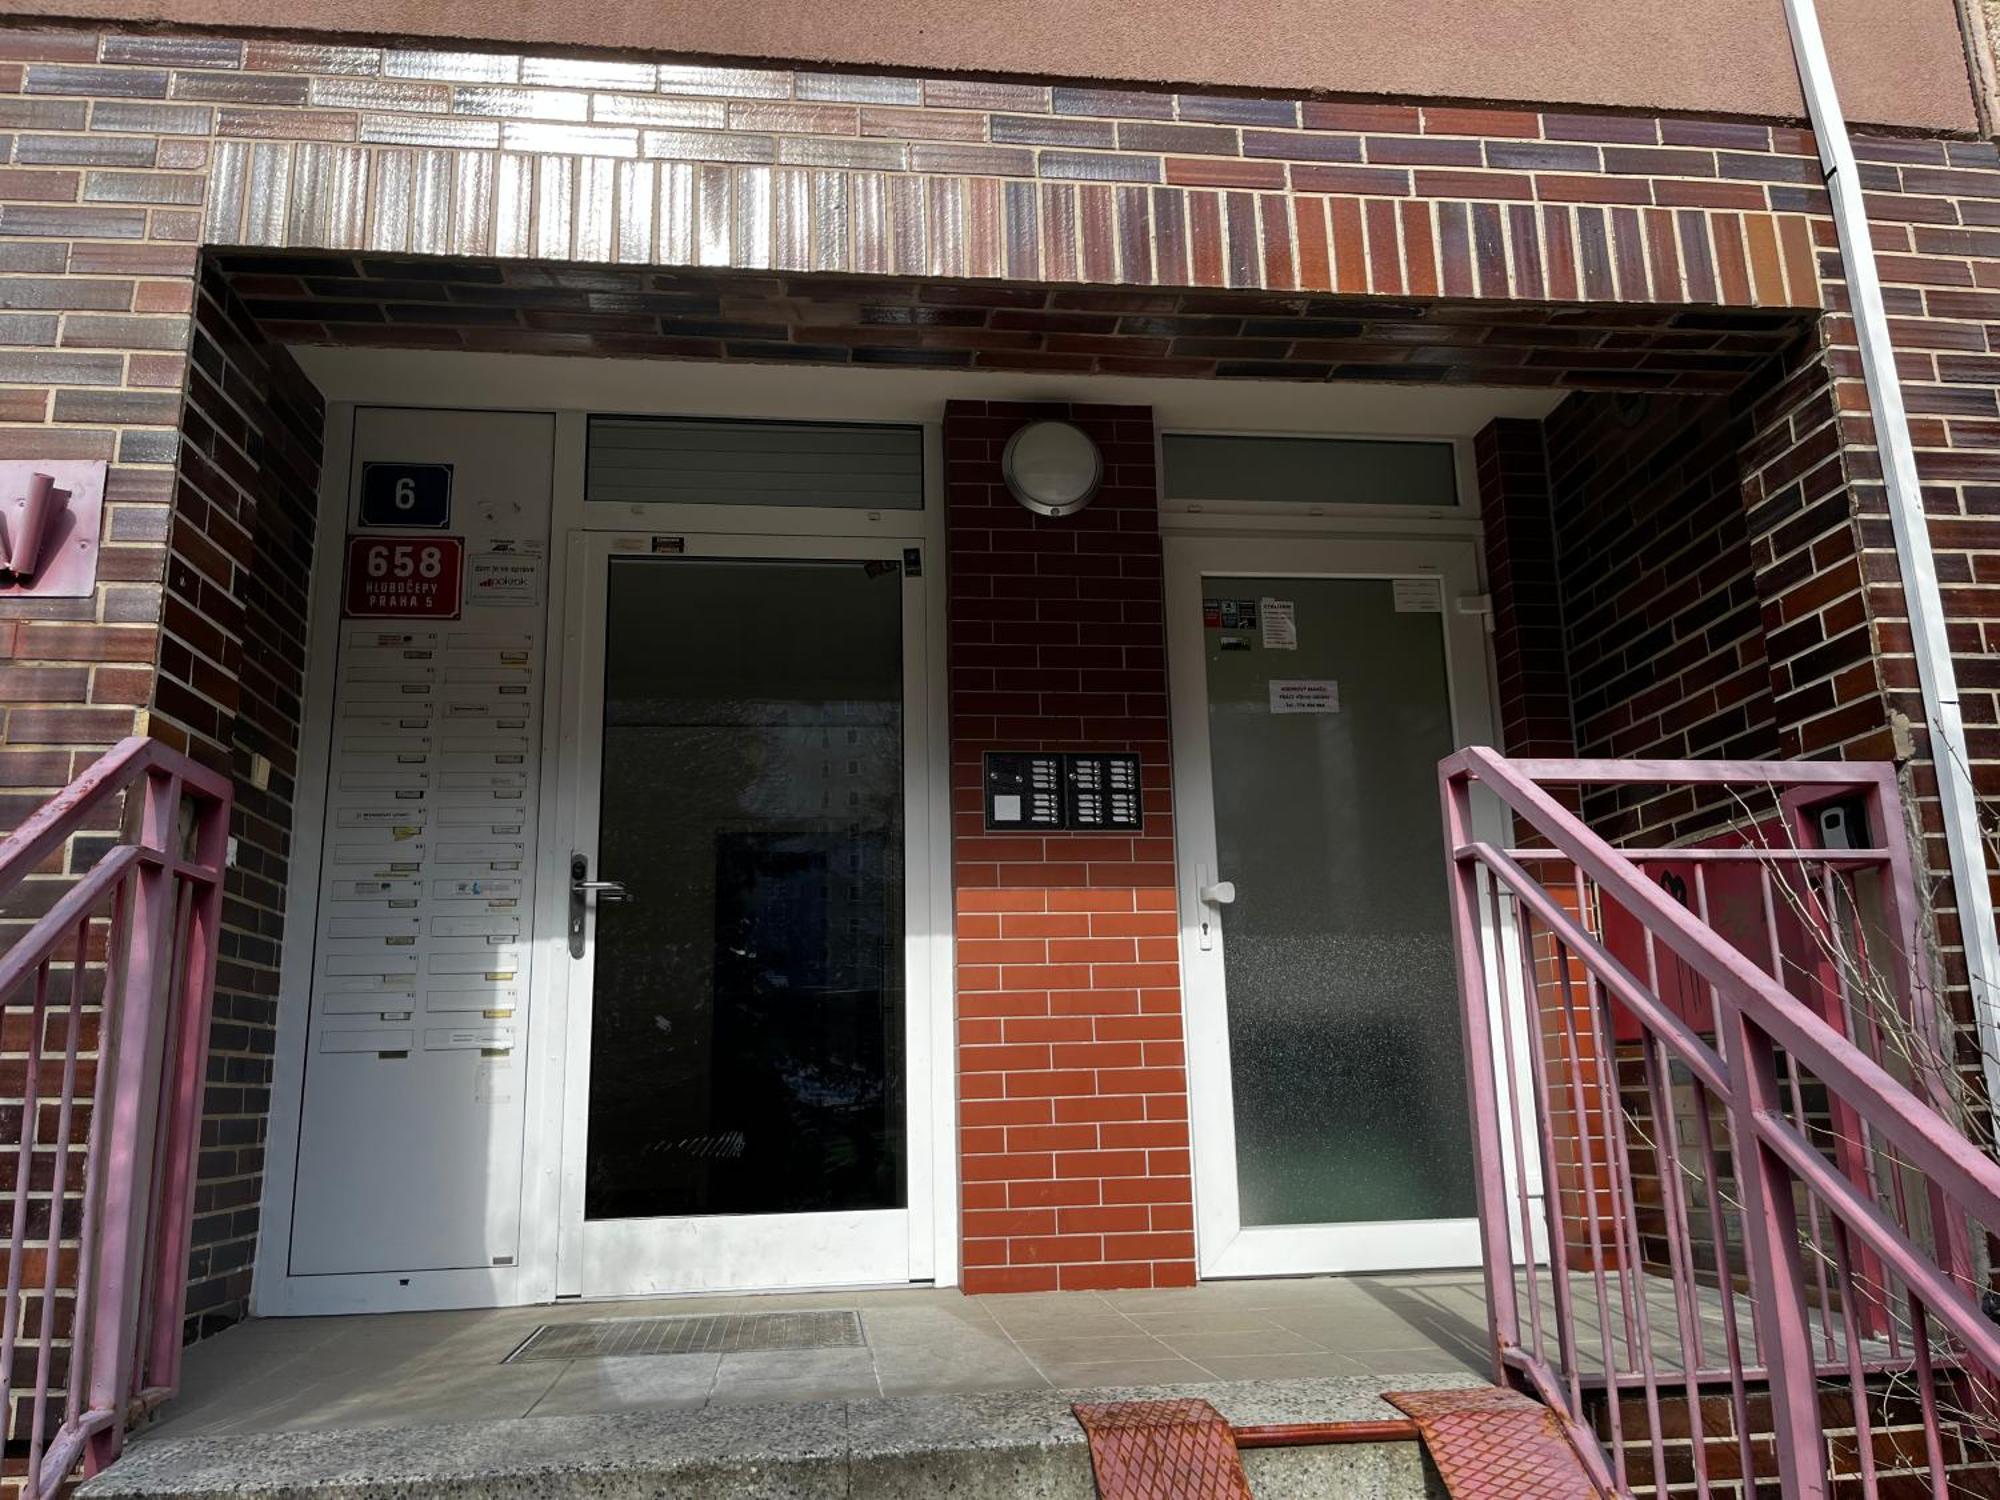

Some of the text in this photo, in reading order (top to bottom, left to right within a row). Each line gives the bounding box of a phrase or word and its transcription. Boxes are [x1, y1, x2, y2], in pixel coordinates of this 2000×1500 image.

[395, 477, 416, 510] 6
[367, 545, 442, 578] 658
[366, 579, 438, 594] HLUBOČEPY
[369, 595, 433, 608] PRAHA 5
